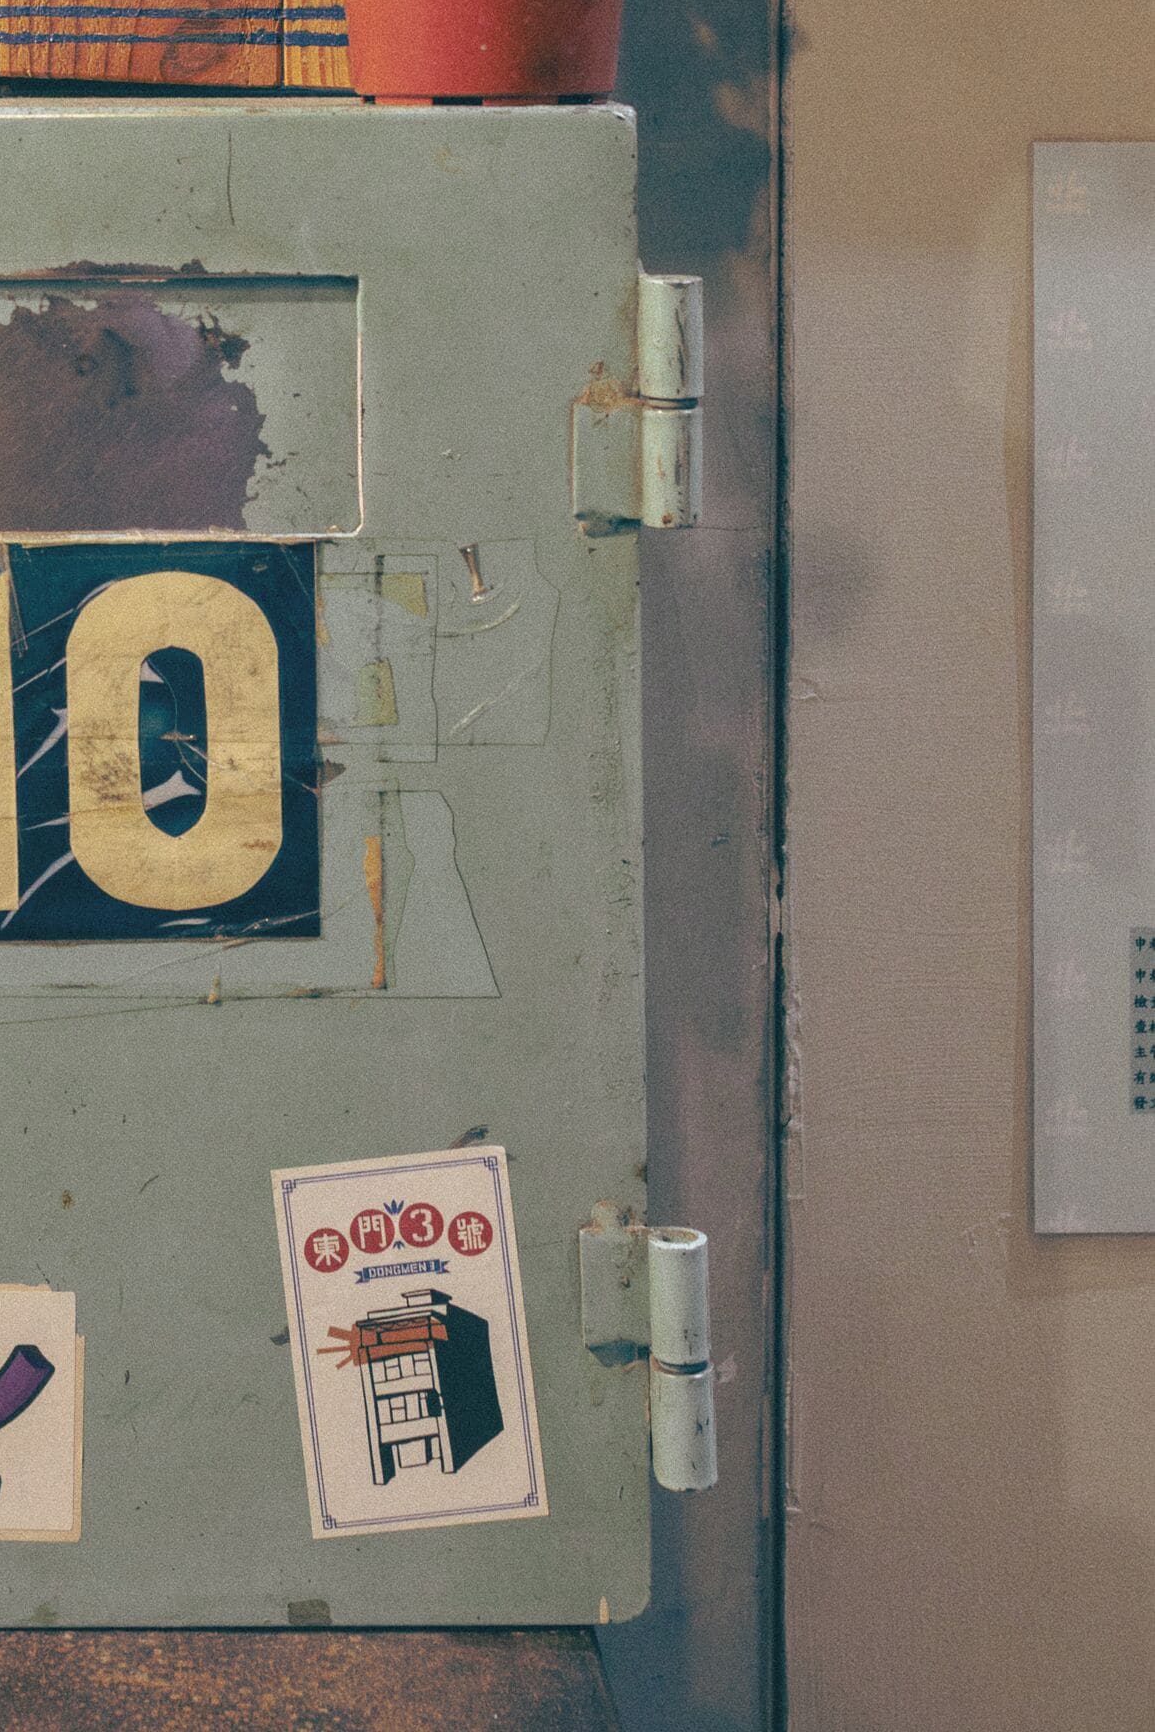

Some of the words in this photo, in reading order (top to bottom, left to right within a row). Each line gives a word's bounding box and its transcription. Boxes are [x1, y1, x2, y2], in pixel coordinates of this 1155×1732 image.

[312, 1208, 487, 1267] 東門3號
[368, 1261, 427, 1278] DONGMEN
